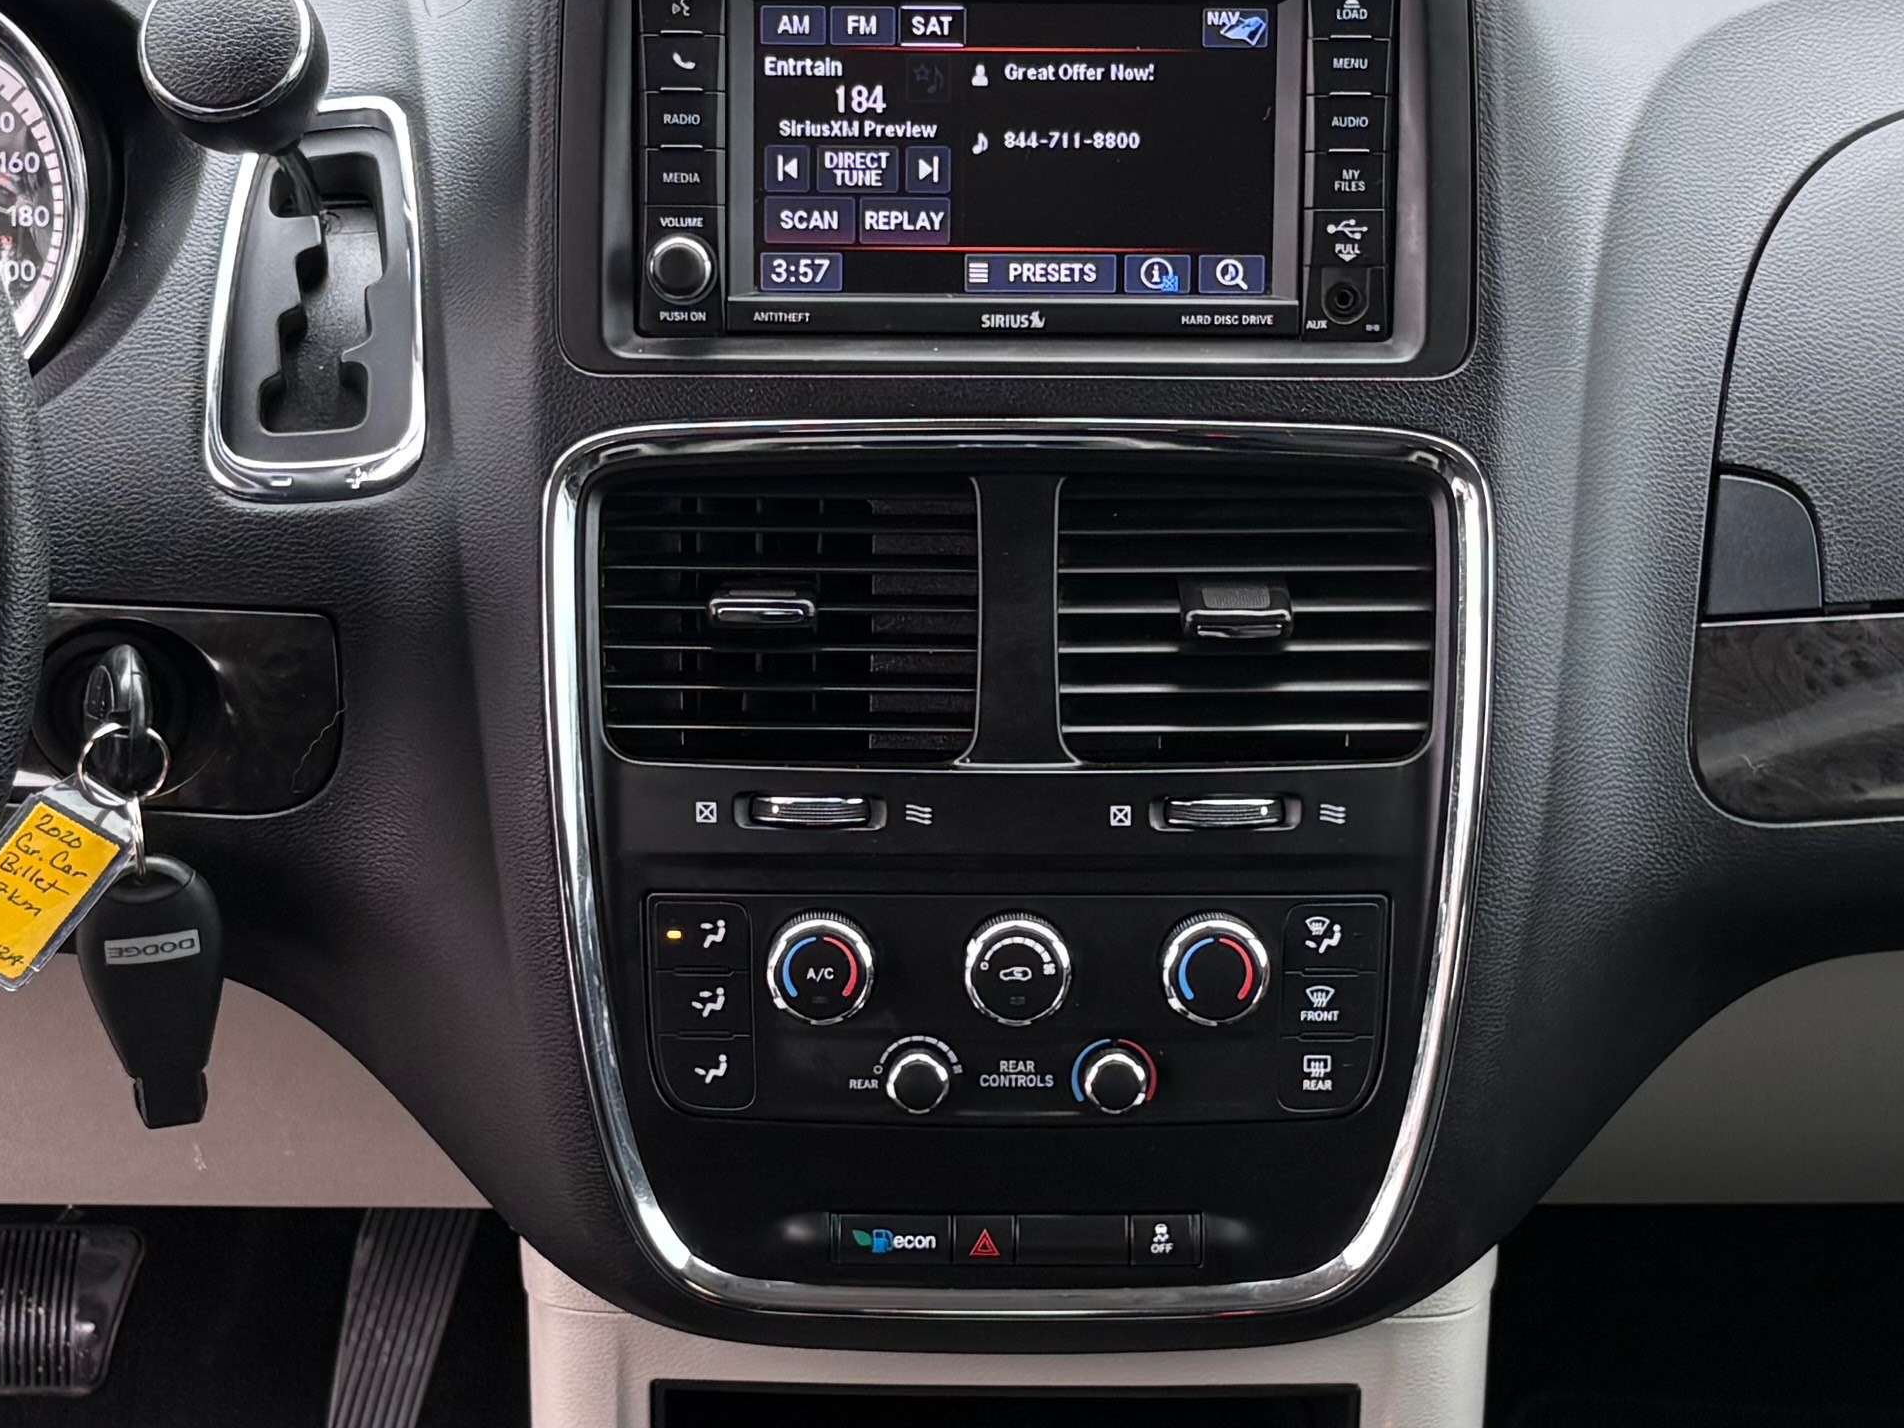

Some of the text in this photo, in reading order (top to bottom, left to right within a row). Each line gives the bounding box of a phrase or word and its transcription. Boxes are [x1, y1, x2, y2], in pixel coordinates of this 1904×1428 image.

[1207, 10, 1240, 26] NAV
[1336, 8, 1368, 20] LOAD
[777, 15, 810, 35] AM
[847, 15, 877, 35] FM
[911, 15, 953, 36] SAT
[764, 56, 843, 77] Entrtain
[1332, 57, 1368, 69] MENU
[1004, 63, 1155, 81] Great Offer Now!
[834, 85, 886, 114] 184
[663, 114, 701, 125] RADIO
[1331, 116, 1369, 128] AUDIO
[779, 120, 937, 139] SiriusXM Preview
[1003, 132, 1141, 149] 844-711-8800
[824, 151, 890, 169] DIRECT
[662, 172, 700, 184] MEDIA
[833, 169, 883, 187] TUNE
[1342, 169, 1361, 180] MY
[1334, 181, 1366, 192] FILES
[8, 206, 50, 227] 180
[660, 216, 704, 228] VOLUME
[780, 210, 839, 230] SCAN
[864, 210, 945, 231] REPLAY
[1334, 243, 1361, 255] PULL
[770, 259, 831, 283] 3:57
[1008, 262, 1097, 283] PRESETS
[659, 311, 706, 322] PUSH ON
[753, 312, 810, 323] ANTITHEFT
[981, 313, 1030, 328] SIRIUS
[1181, 315, 1274, 325] HARD DISC DRIVE
[1306, 320, 1328, 330] AUX
[35, 814, 82, 849] 2020
[0, 852, 70, 896] Billet
[106, 938, 195, 958] DODGE
[806, 967, 834, 983] A/C
[1300, 1010, 1339, 1021] FRONT
[999, 1060, 1035, 1072] REAR
[849, 1079, 879, 1090] REAR
[979, 1074, 1054, 1088] CONTROLS
[1302, 1080, 1332, 1091] REAR
[893, 1233, 936, 1250] econ
[1150, 1243, 1174, 1254] OFF
